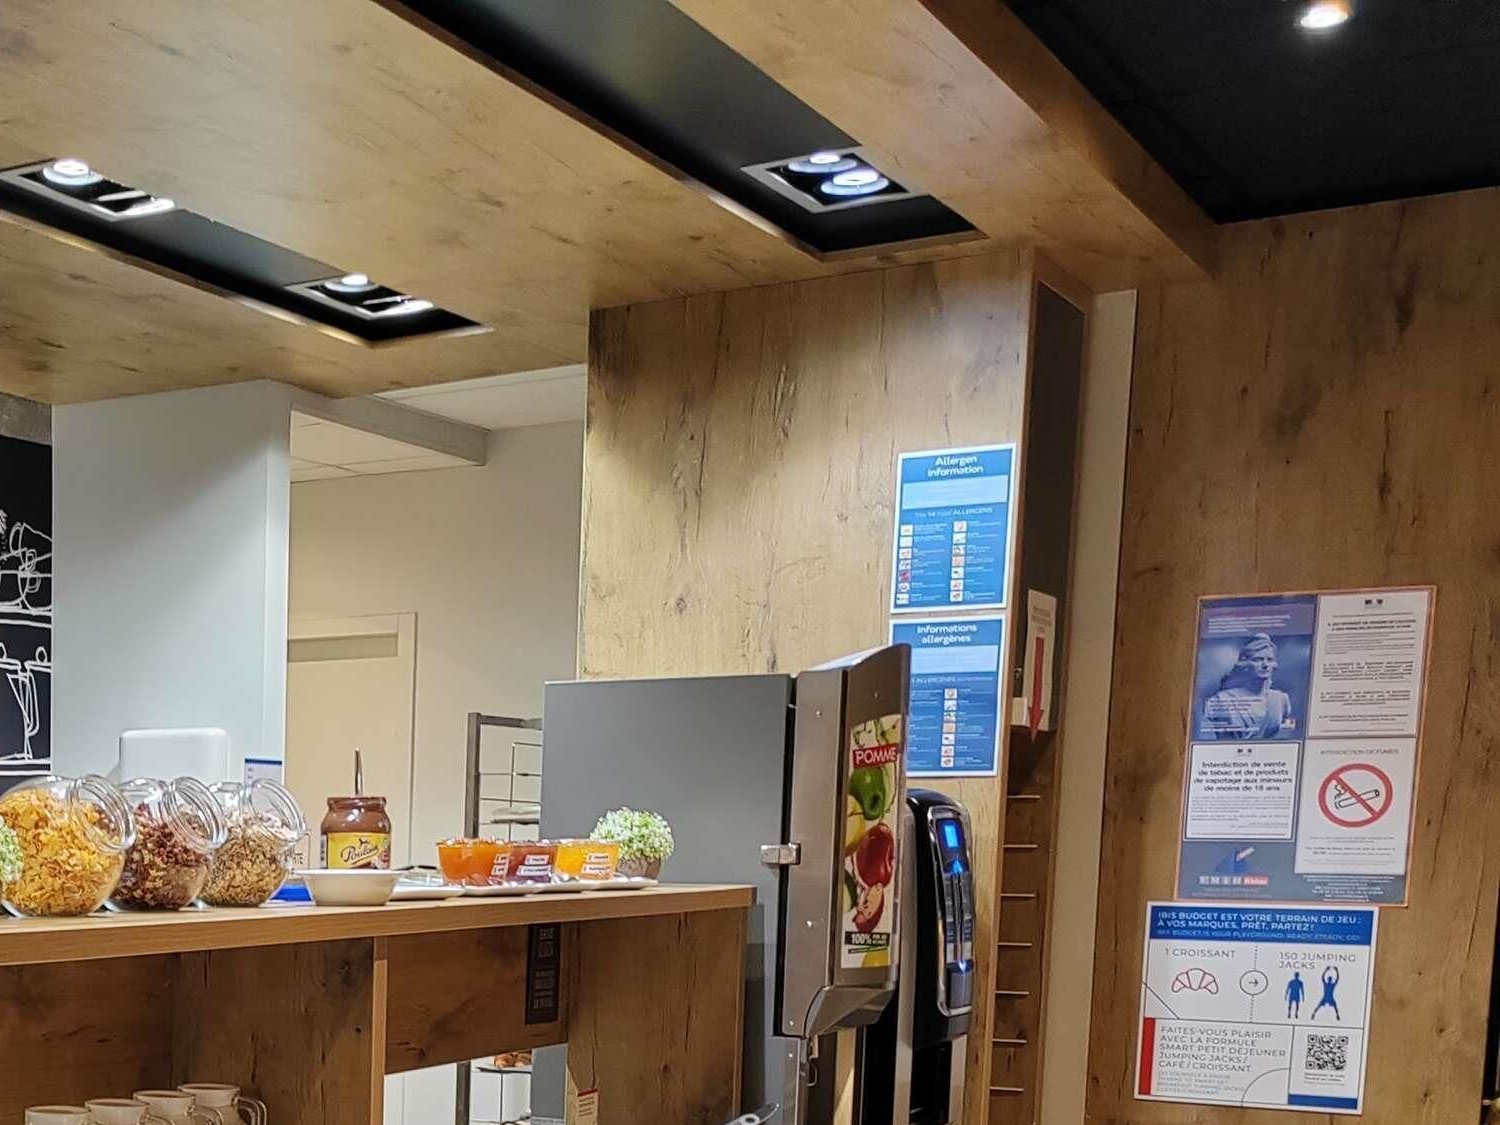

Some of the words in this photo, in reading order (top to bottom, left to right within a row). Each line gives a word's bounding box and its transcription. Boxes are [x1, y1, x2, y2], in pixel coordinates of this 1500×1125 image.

[935, 455, 978, 466] Allergen
[916, 624, 978, 634] Informations
[855, 746, 897, 765] POMME
[1256, 770, 1289, 778] produits
[1178, 911, 1219, 921] BUDGET
[1220, 912, 1238, 921] EST
[1240, 913, 1273, 923] VOTRE
[1275, 914, 1318, 924] TERRAIN
[1320, 915, 1336, 924] DE
[1166, 919, 1187, 928] VOS
[1172, 948, 1236, 959] CROISSANT
[1279, 952, 1298, 961] 150
[1301, 953, 1356, 963] JUMPING
[1278, 960, 1316, 970] JACKS
[1161, 1025, 1228, 1037] FAITES-VOUS
[1231, 1030, 1272, 1039] PLAISIR
[1160, 1035, 1187, 1043] AVEC
[1189, 1036, 1202, 1044] LA
[1205, 1037, 1257, 1047] FORMULE
[1160, 1043, 1195, 1052] SMART
[1197, 1045, 1227, 1054] PETIT
[1159, 1052, 1206, 1062] JUMPING
